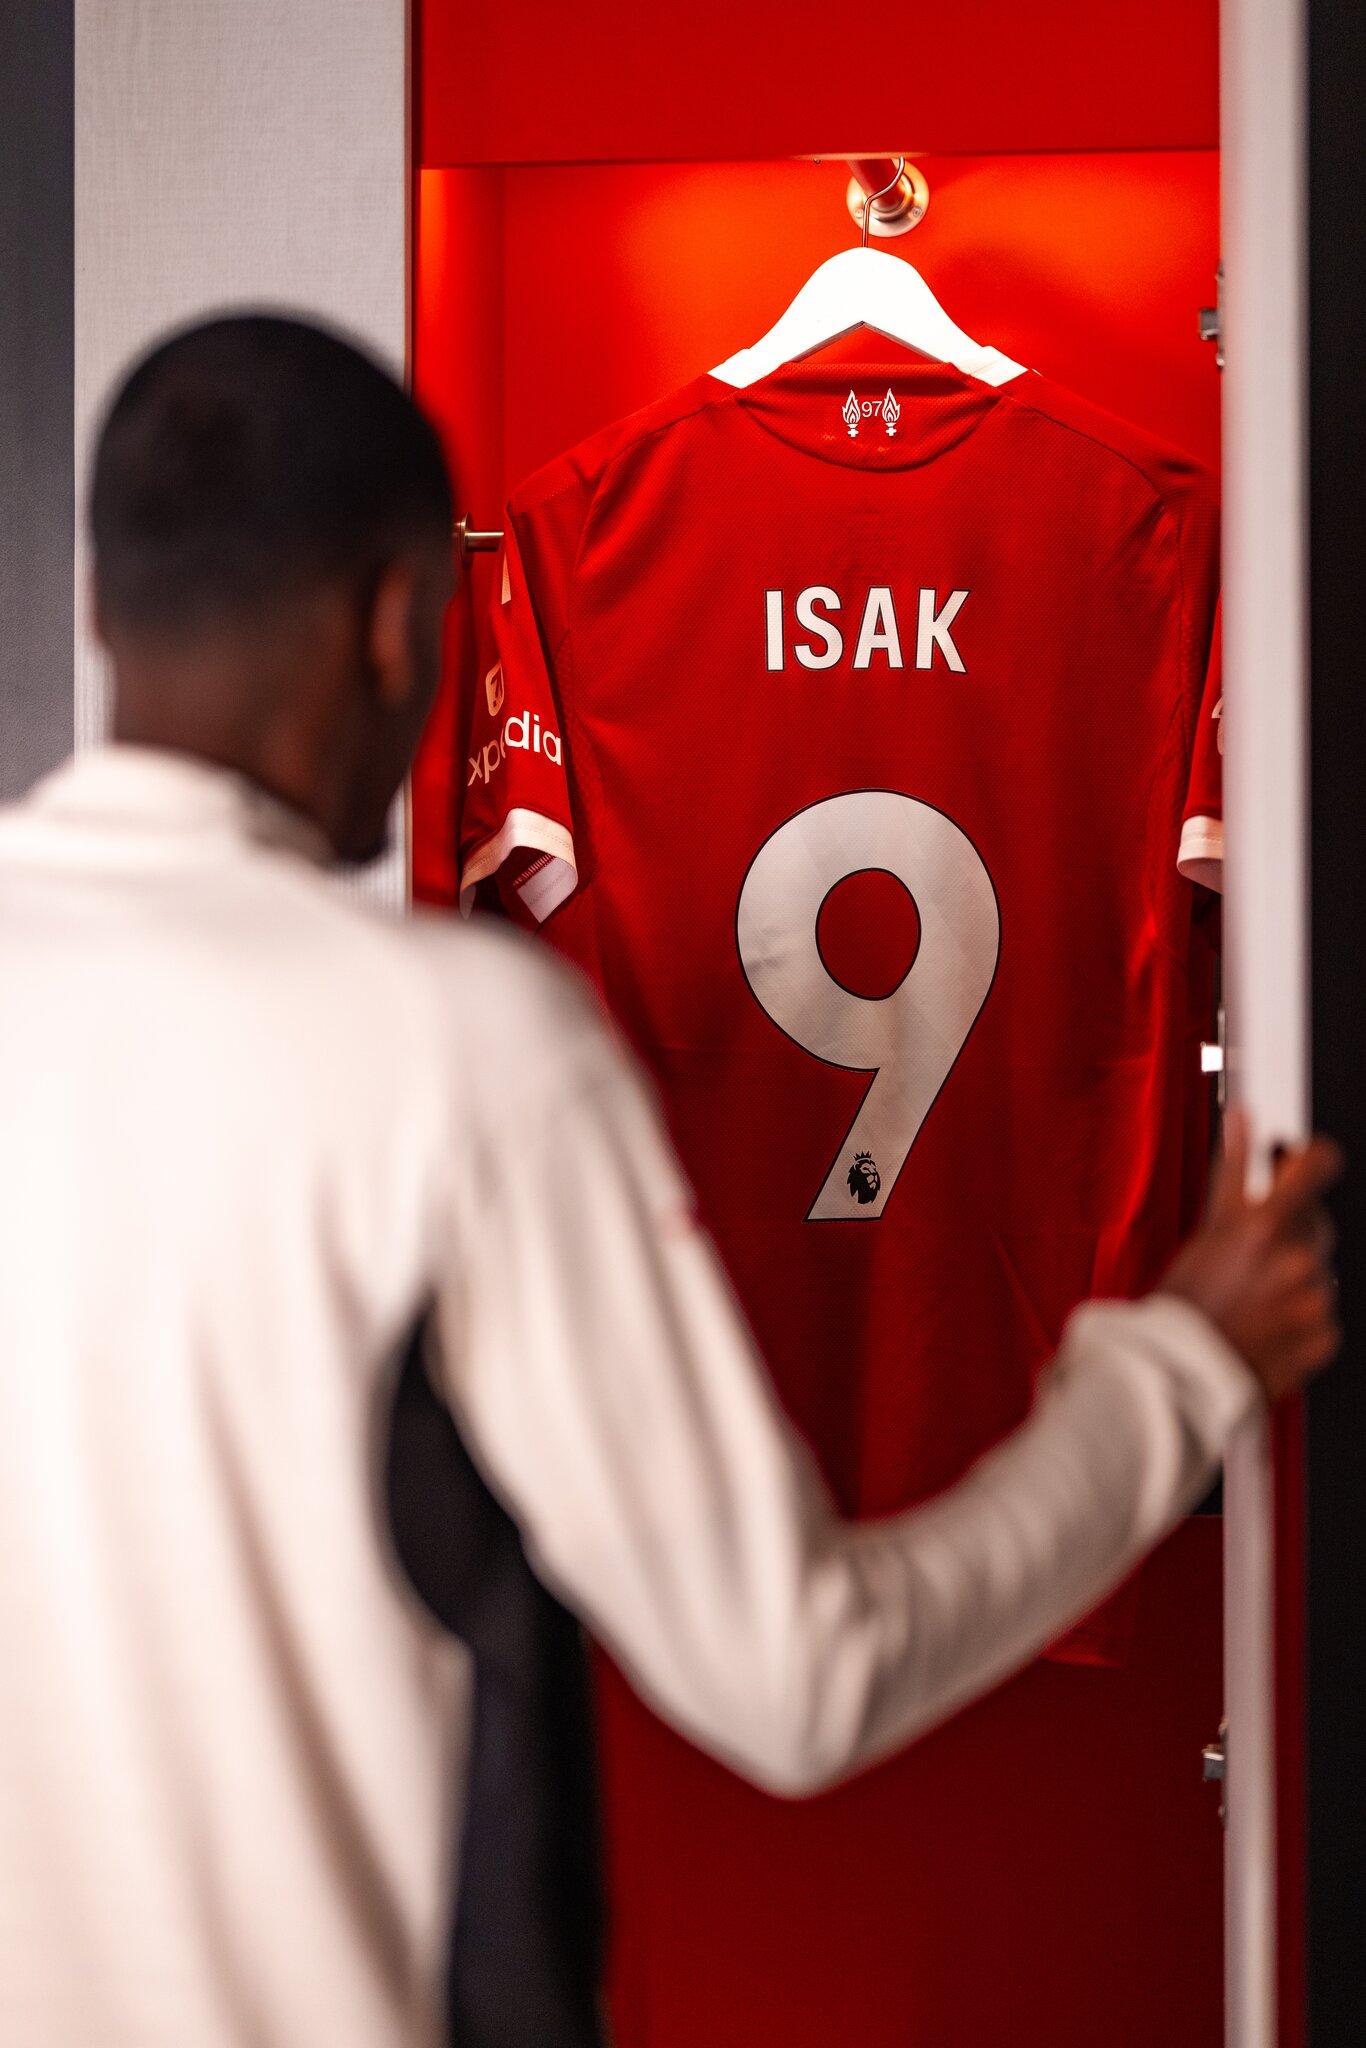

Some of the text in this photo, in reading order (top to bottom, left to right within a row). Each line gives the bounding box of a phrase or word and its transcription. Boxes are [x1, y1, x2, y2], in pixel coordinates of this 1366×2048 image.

[861, 401, 883, 418] 97
[764, 584, 972, 674] ISAK
[735, 788, 1002, 1223] 9
